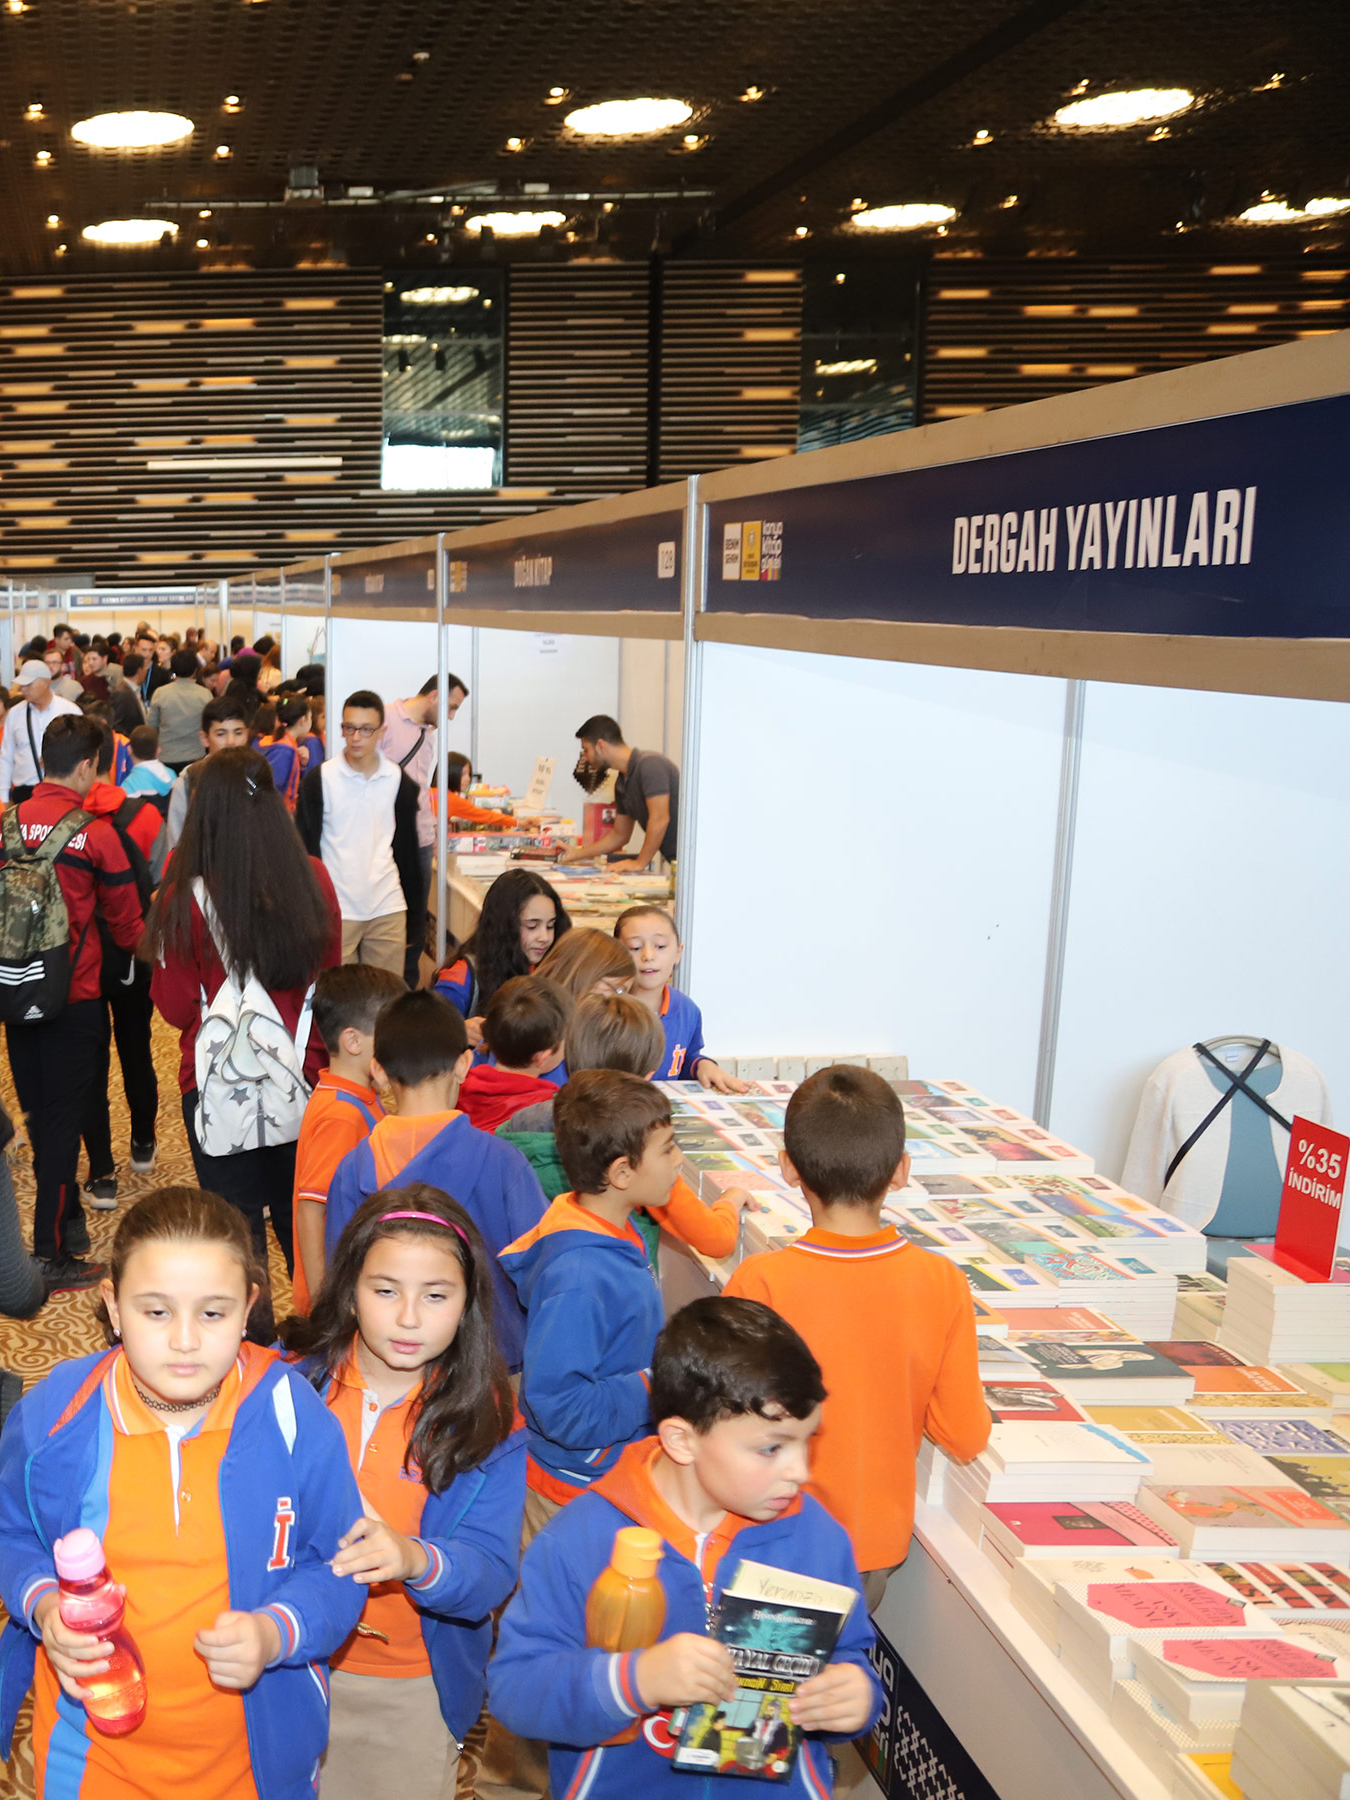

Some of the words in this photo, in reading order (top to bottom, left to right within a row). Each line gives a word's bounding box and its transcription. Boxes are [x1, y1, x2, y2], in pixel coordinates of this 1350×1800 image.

[952, 507, 1058, 576] DERGAH
[1066, 485, 1258, 572] YAYINLARI
[1288, 1167, 1342, 1210] İNDİRİM
[1298, 1139, 1342, 1180] %35
[267, 1496, 296, 1572] İ
